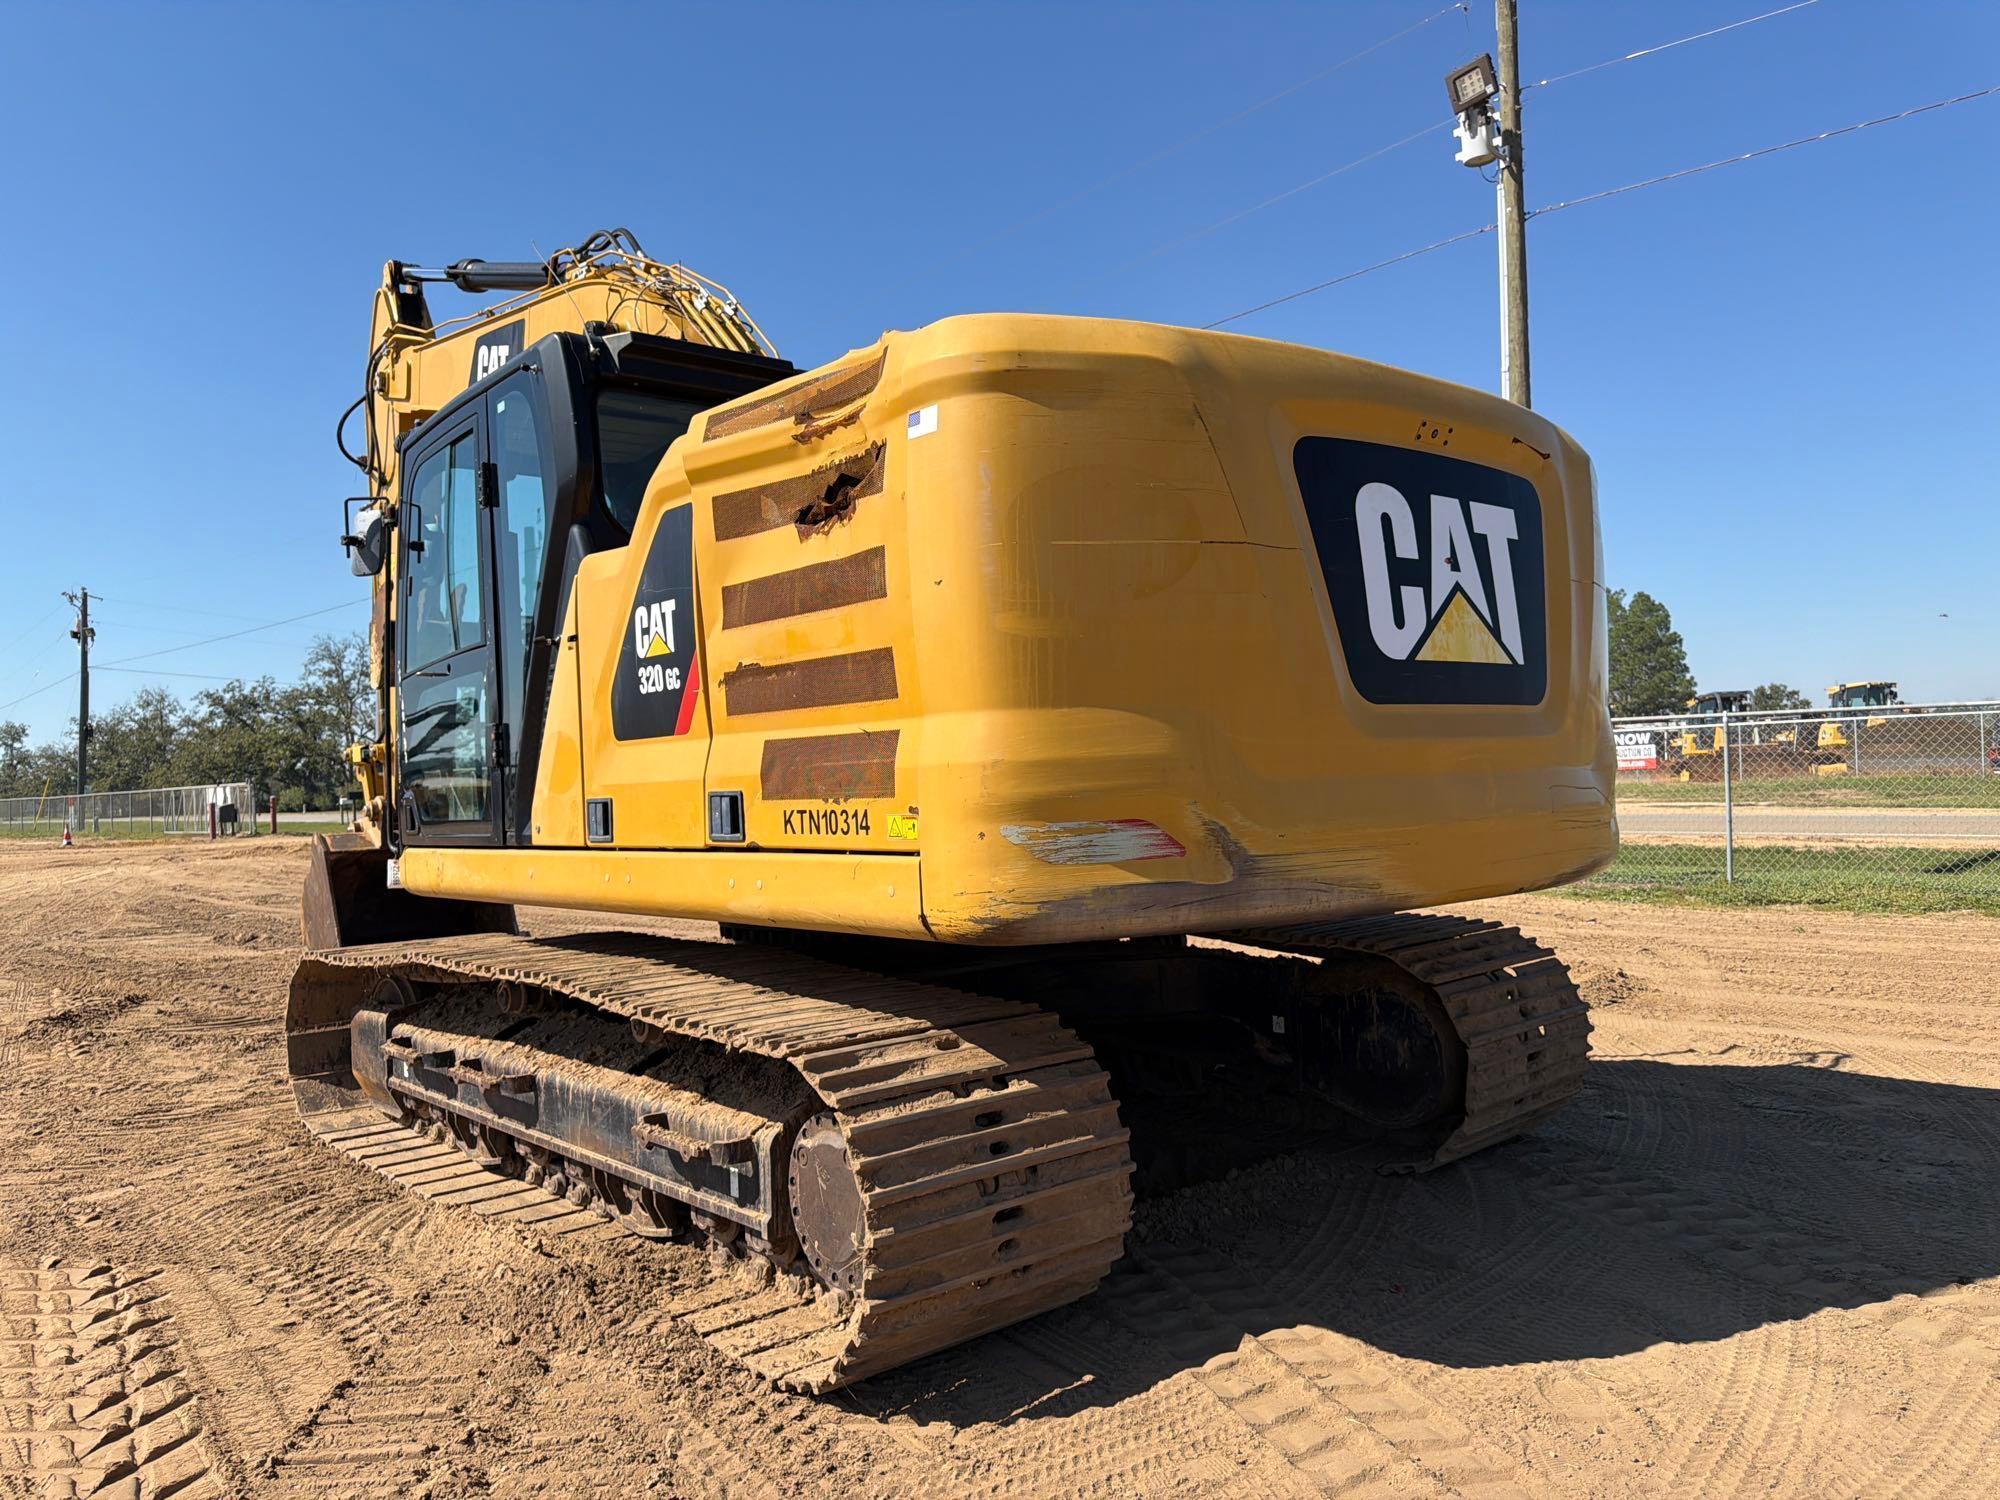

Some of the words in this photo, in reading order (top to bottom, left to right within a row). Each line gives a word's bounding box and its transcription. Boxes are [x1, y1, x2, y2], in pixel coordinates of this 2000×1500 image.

[477, 345, 509, 381] CAT
[1355, 482, 1525, 665] CAT
[635, 599, 676, 658] CAT
[638, 664, 664, 694] 320
[665, 667, 681, 690] GC
[1614, 732, 1651, 746] NOW
[783, 809, 870, 835] KTN10314
